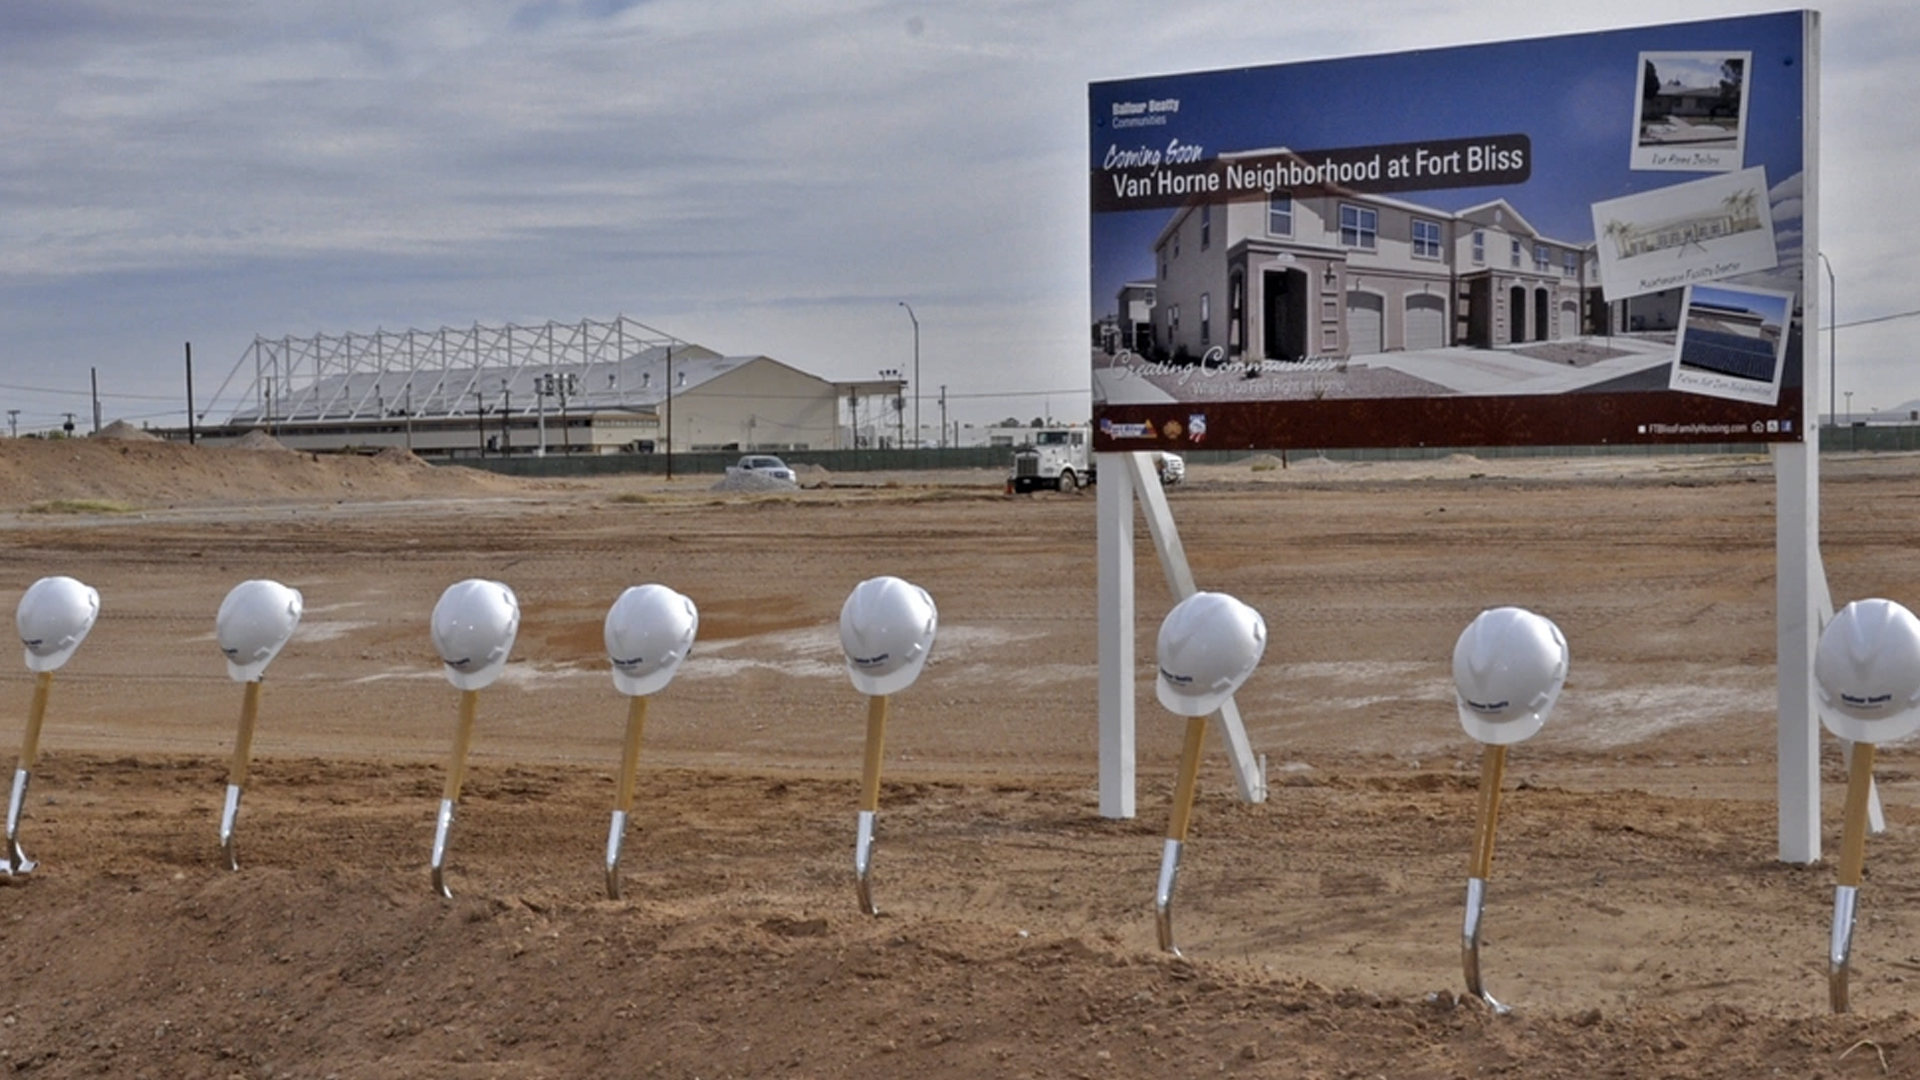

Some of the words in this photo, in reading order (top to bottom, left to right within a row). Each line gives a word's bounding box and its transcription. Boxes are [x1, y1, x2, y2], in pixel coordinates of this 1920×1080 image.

[1112, 115, 1167, 128] Communities
[1103, 144, 1161, 175] Coming
[1165, 138, 1203, 165] Soon
[1112, 173, 1152, 198] Van
[1157, 169, 1220, 195] Horne
[1226, 153, 1380, 194] Neighborhood
[1387, 157, 1410, 178] at
[1416, 148, 1461, 176] Fort
[1467, 144, 1524, 172] Bliss
[1110, 350, 1198, 385] Creating
[1200, 345, 1341, 378] Communities
